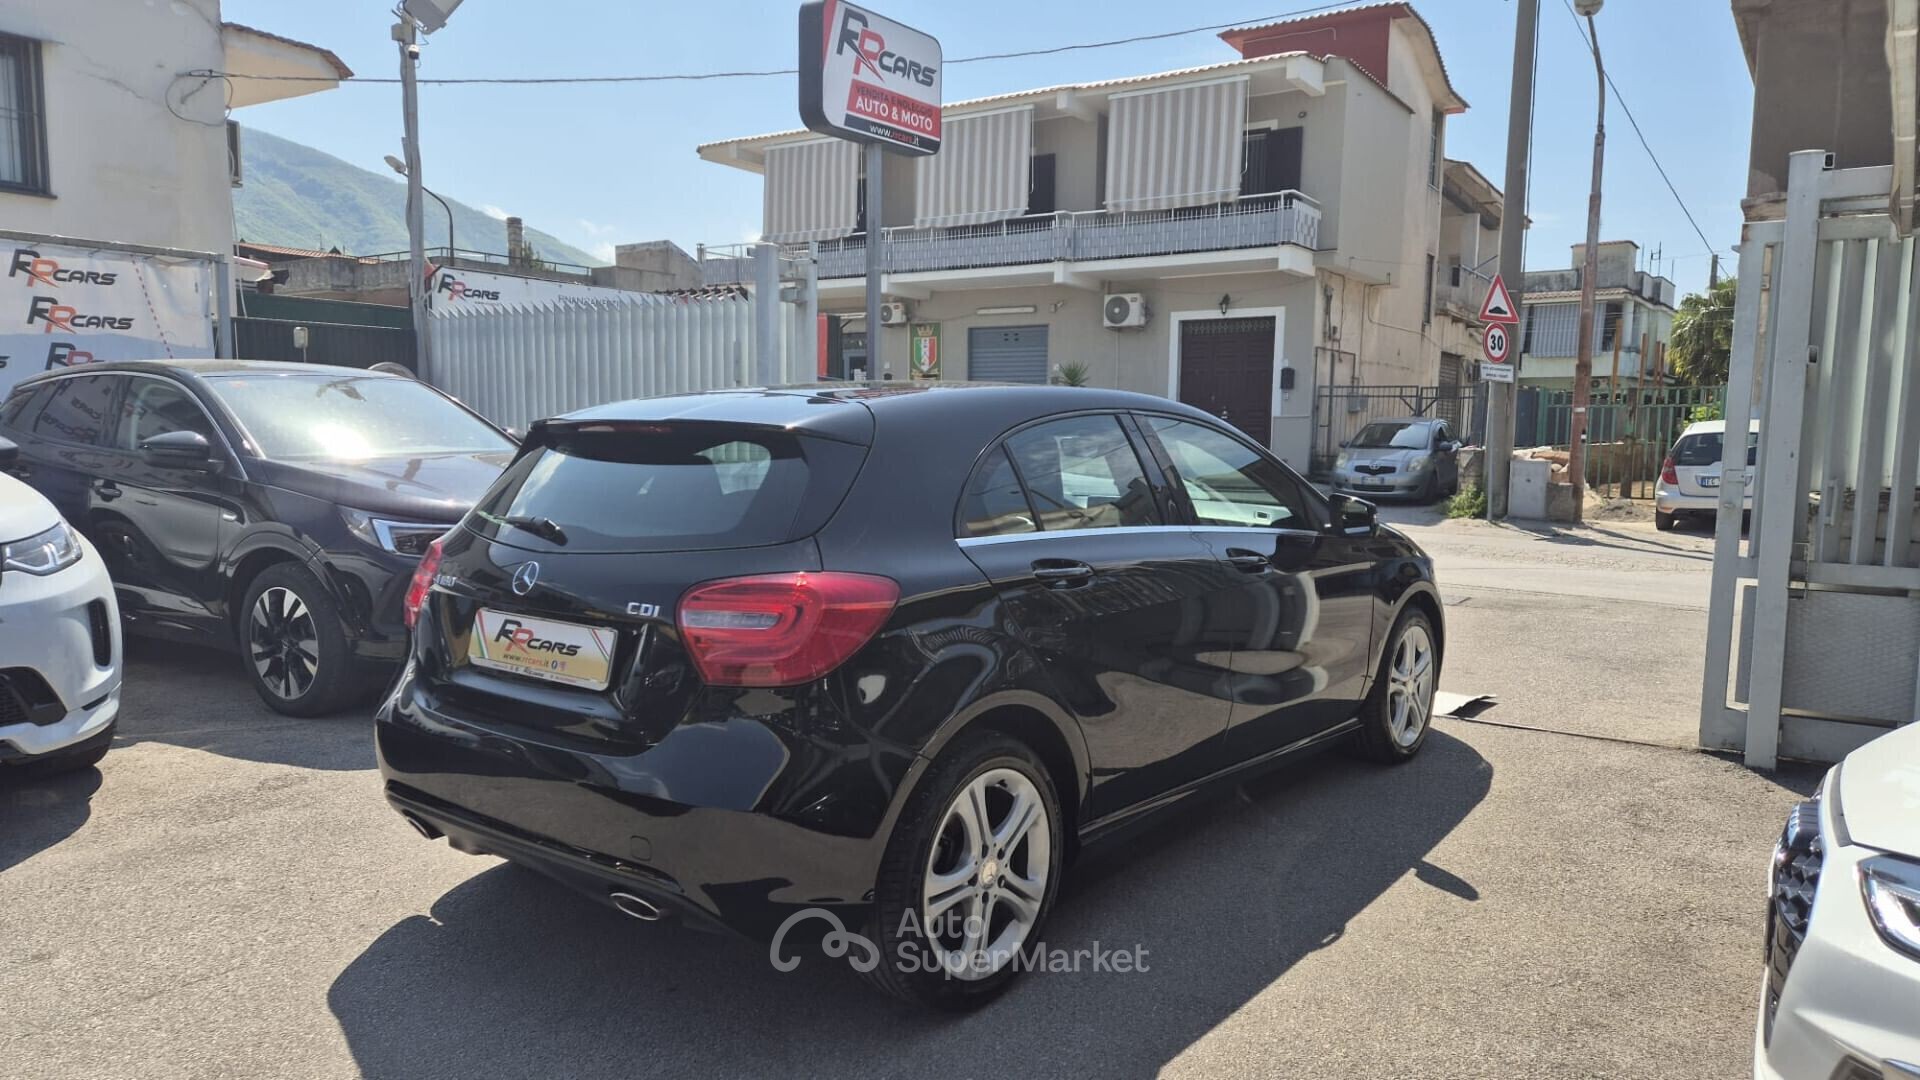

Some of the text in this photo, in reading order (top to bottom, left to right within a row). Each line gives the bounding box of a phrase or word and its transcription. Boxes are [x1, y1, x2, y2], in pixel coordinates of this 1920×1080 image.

[855, 96, 933, 131] AUTO & MOTO
[1490, 334, 1504, 351] 30
[627, 602, 660, 617] CDI
